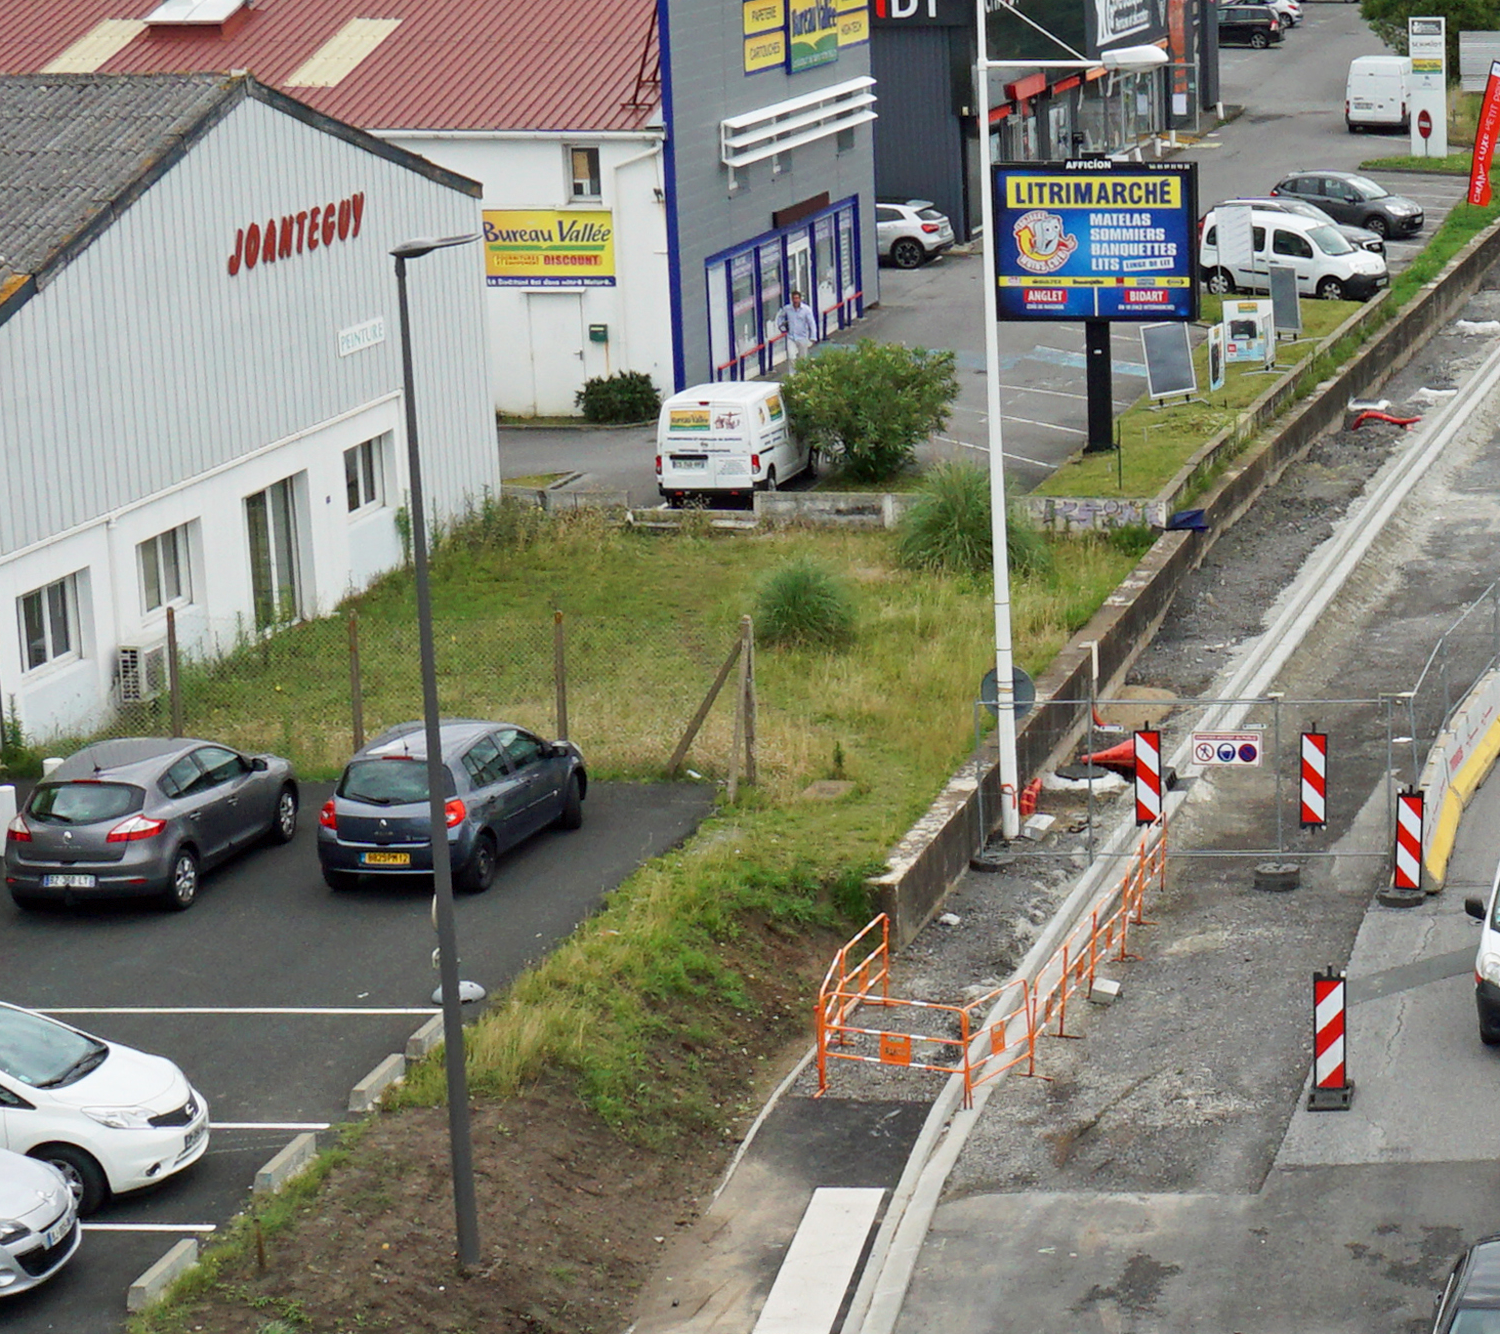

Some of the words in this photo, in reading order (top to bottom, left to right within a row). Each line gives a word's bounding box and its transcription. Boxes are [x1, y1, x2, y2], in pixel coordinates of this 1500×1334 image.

[791, 7, 817, 38] Bureau
[1014, 178, 1172, 205] LITRIMARCHÉ
[1089, 213, 1151, 227] MATELAS
[227, 191, 365, 277] JOANTEGUY
[482, 221, 553, 242] Bureau
[557, 220, 612, 242] Vallée
[1090, 228, 1165, 241] SOMMIERS
[1091, 243, 1177, 257] BANQUETTES
[543, 254, 600, 266] DISCOUNT
[1091, 258, 1120, 271] LITS
[1124, 260, 1148, 269] LINGE
[1160, 258, 1171, 267] LIT
[1028, 291, 1063, 302] ANGLET
[1129, 291, 1164, 302] BIDART
[340, 321, 384, 352] PEINTURE
